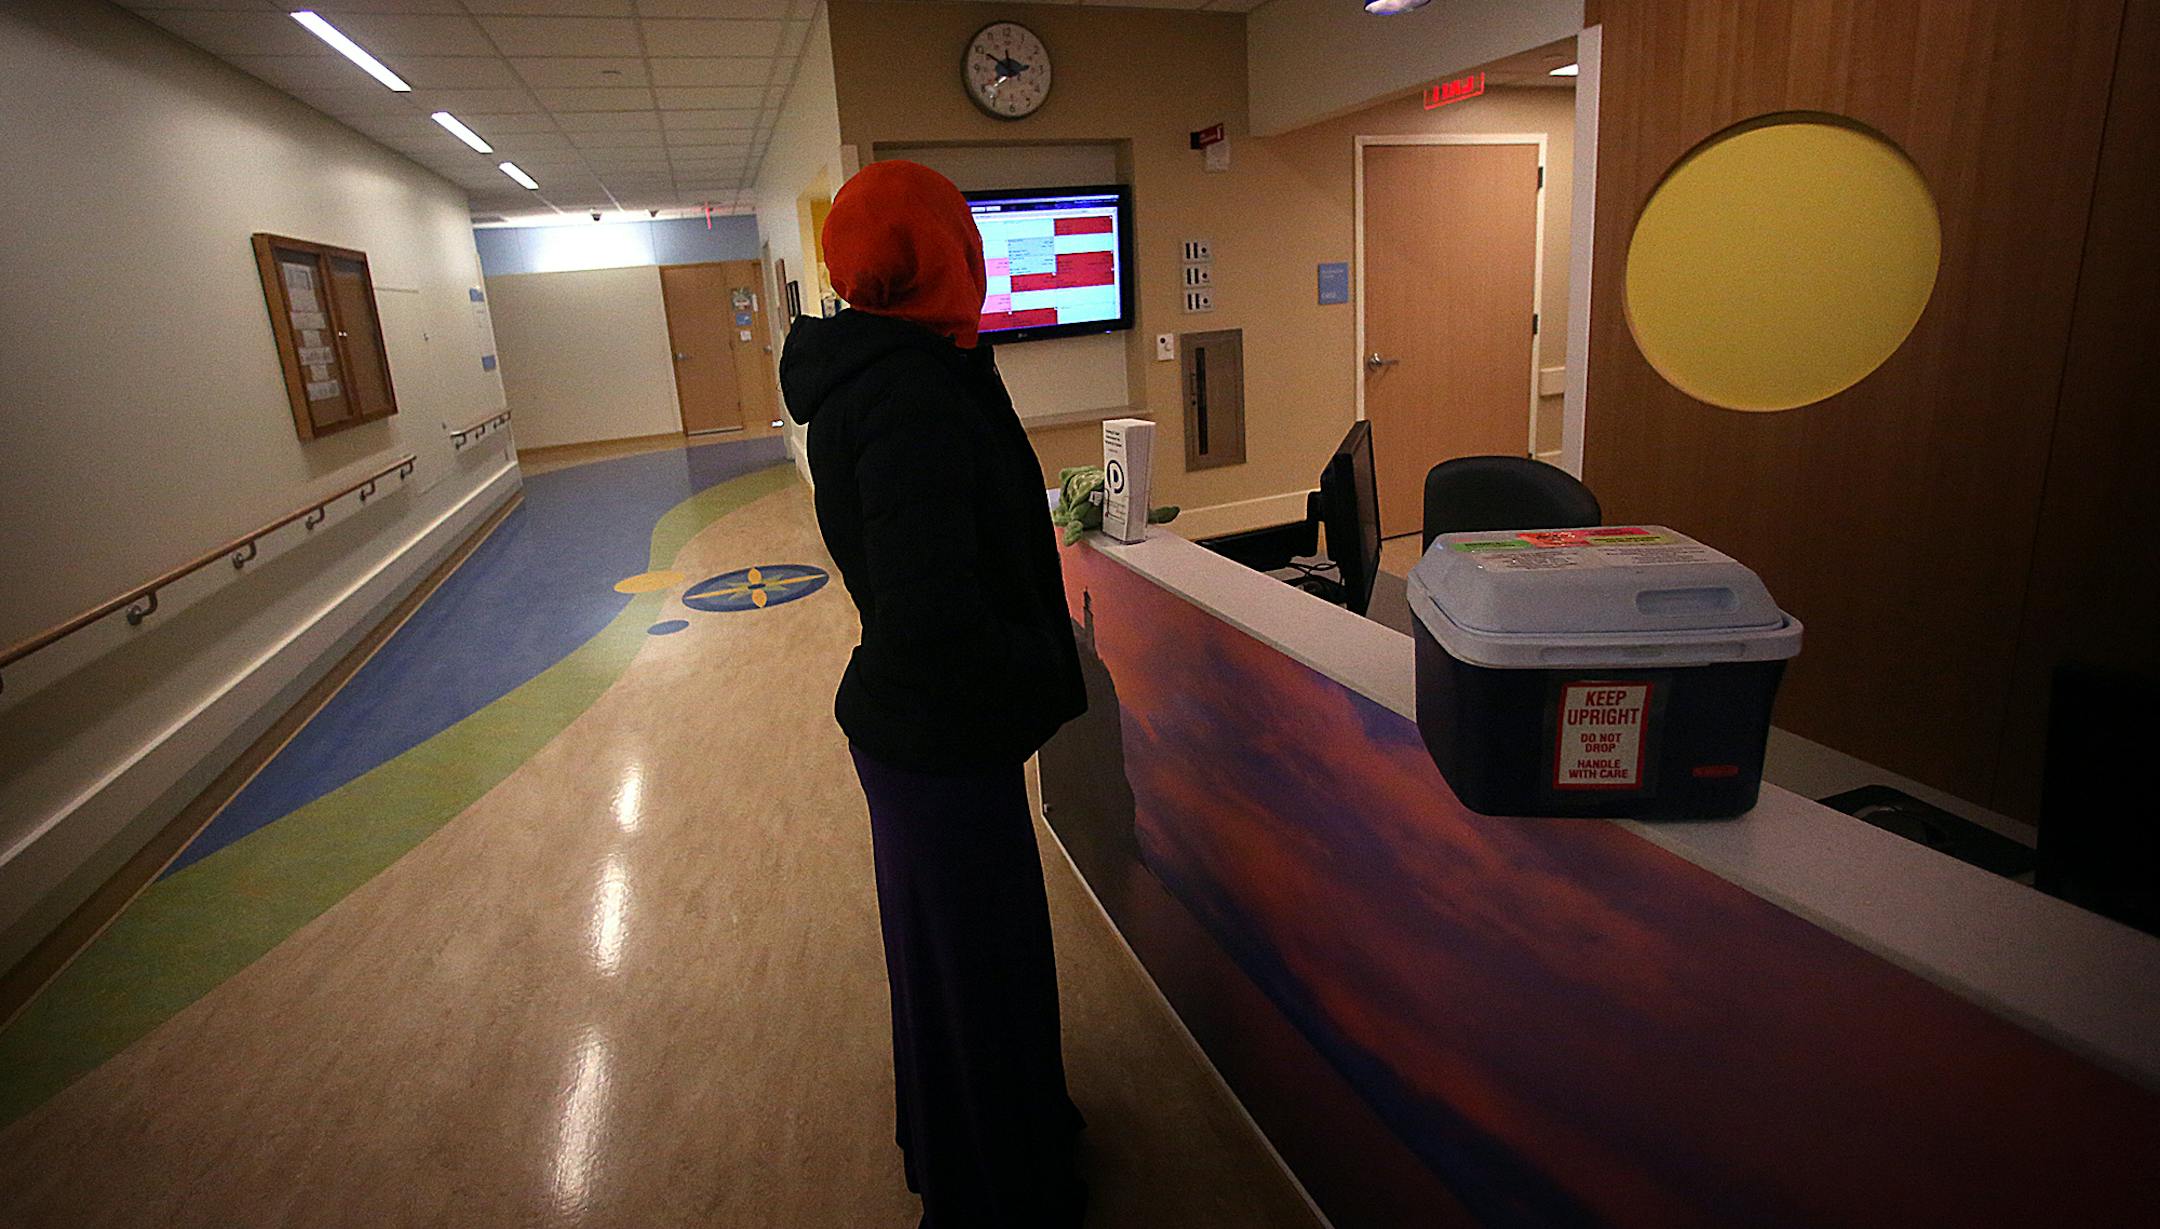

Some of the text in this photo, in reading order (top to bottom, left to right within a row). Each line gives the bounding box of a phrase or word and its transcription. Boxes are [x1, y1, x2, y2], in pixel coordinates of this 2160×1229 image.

[1586, 690, 1627, 706] KEEP
[1567, 707, 1640, 726] UPRIGHT
[1580, 732, 1622, 743] DO NOT
[1585, 743, 1616, 753] DROP
[1577, 759, 1621, 769] HANDLE
[1568, 769, 1628, 779] WITH CARE
